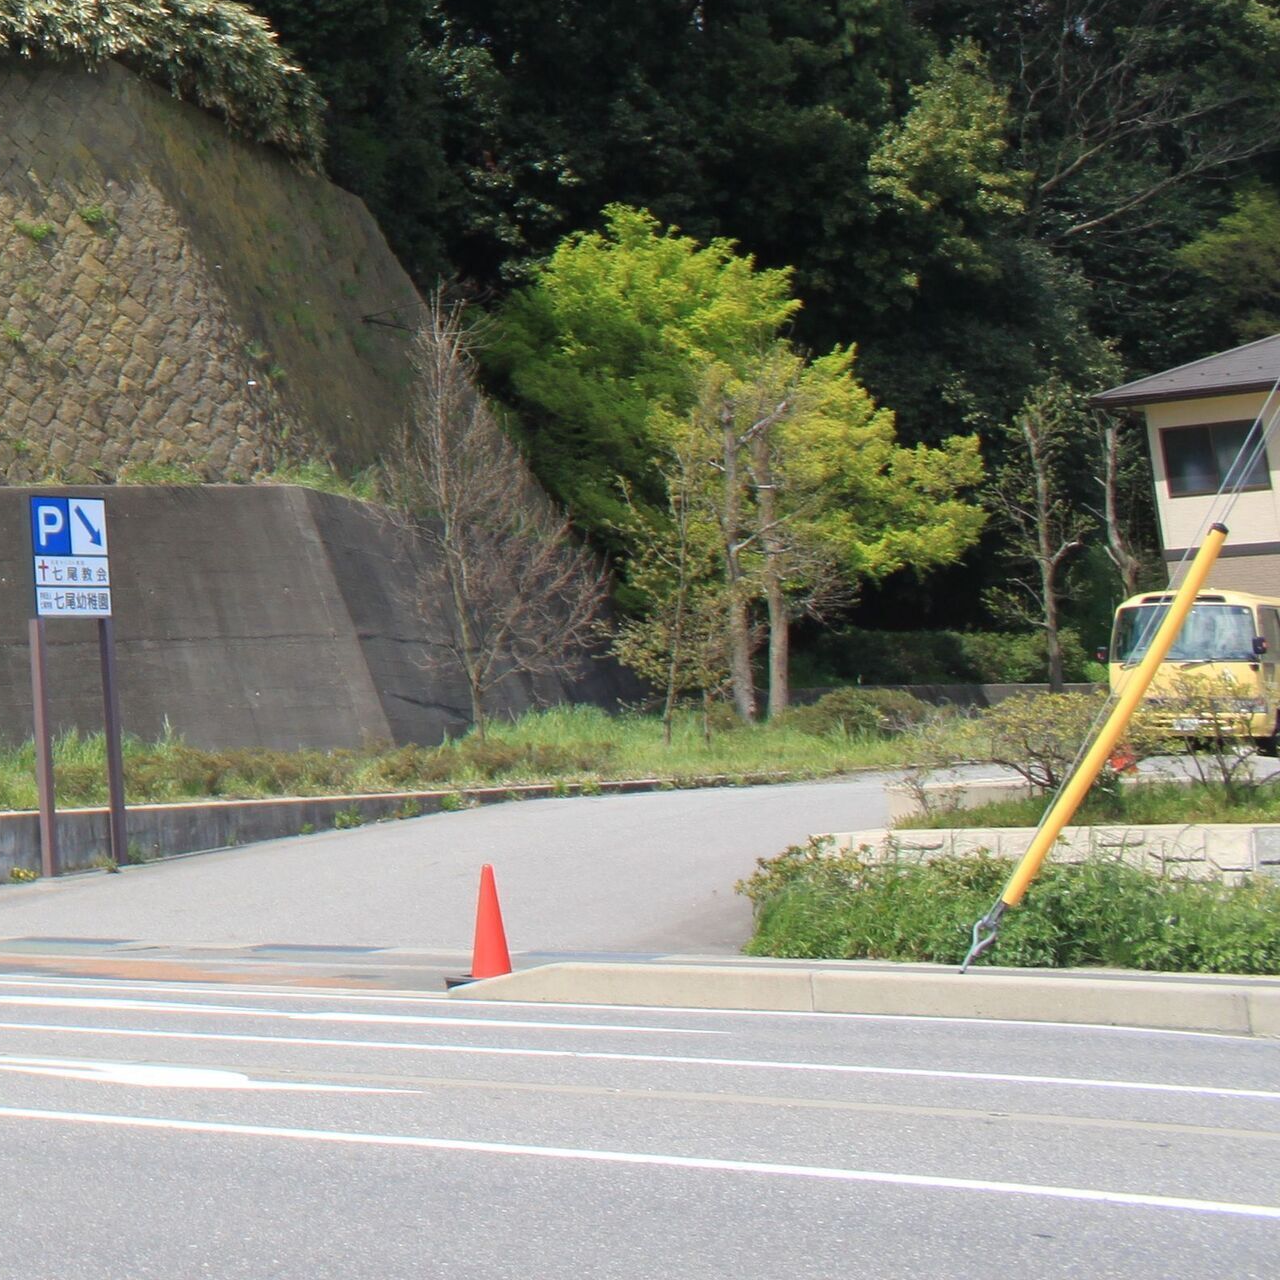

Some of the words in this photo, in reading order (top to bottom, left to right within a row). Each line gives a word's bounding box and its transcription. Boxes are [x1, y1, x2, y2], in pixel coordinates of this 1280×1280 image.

[38, 505, 63, 546] P
[52, 566, 107, 582] 七尾教会
[54, 592, 109, 610] 七尾幼稚園
